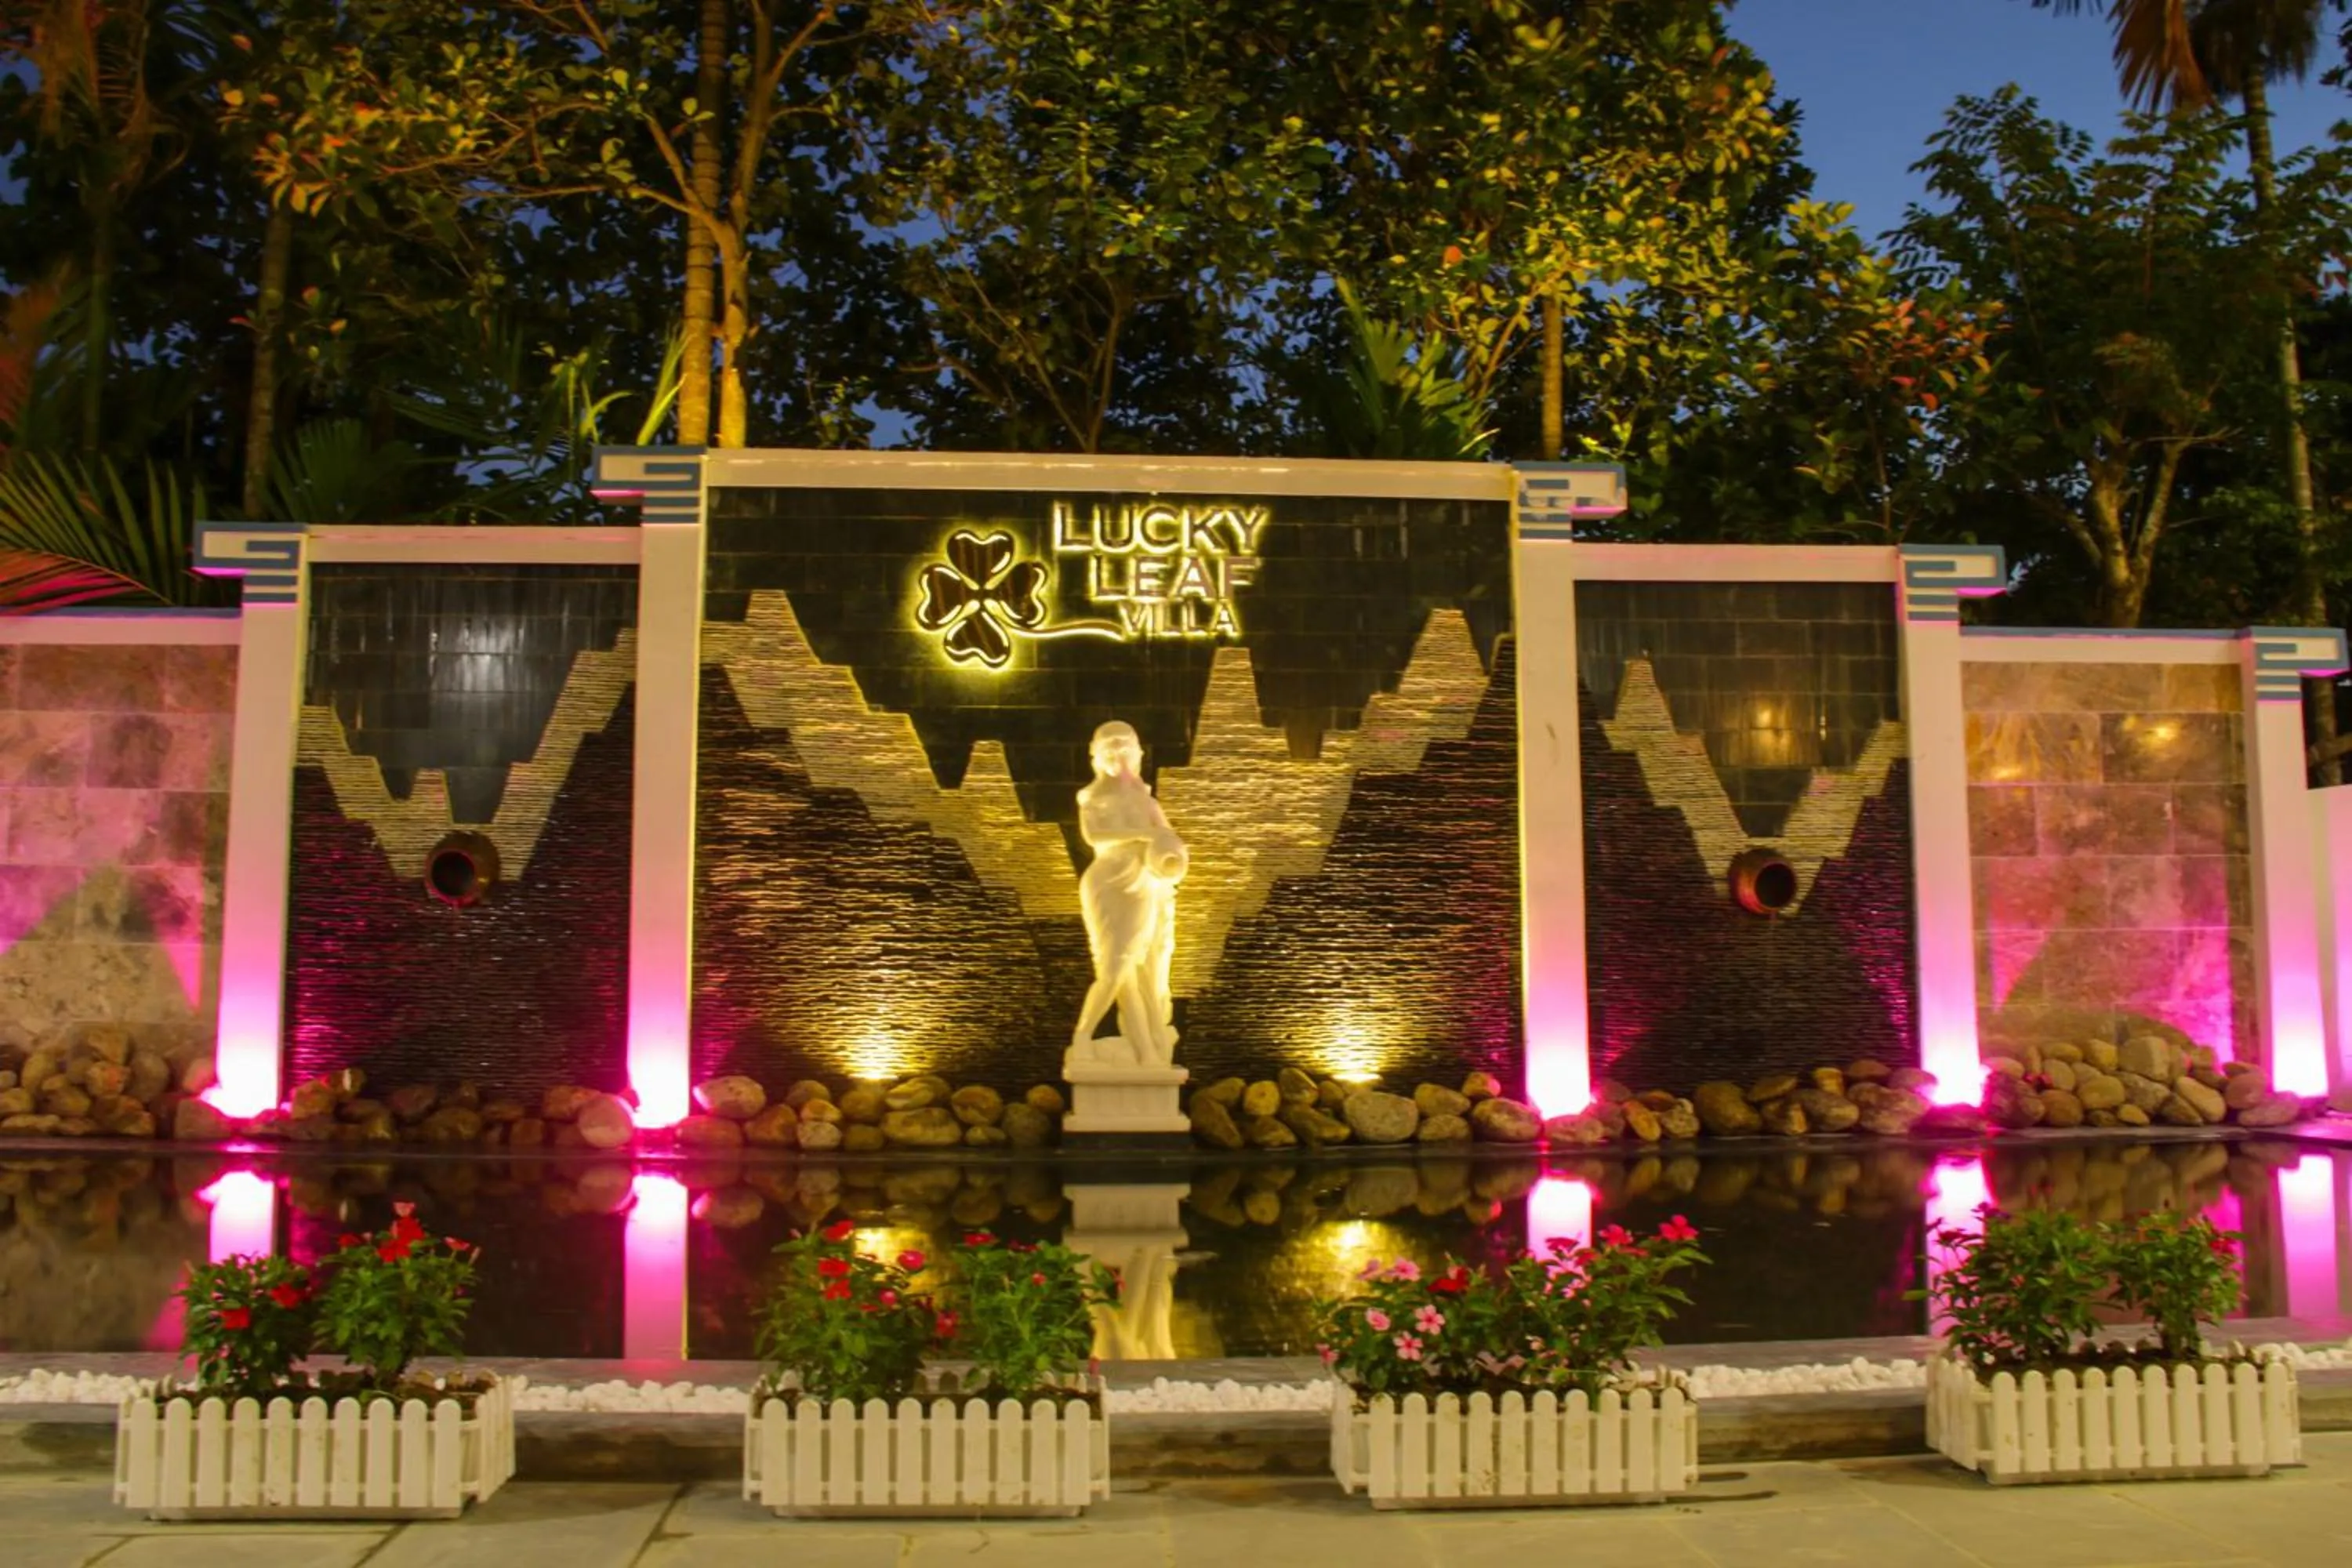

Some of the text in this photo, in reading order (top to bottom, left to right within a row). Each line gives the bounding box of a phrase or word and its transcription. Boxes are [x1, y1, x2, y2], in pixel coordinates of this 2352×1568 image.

[1053, 502, 1269, 552] LUCKY
[1090, 554, 1258, 601] LEAF
[1119, 601, 1240, 637] VILLA
